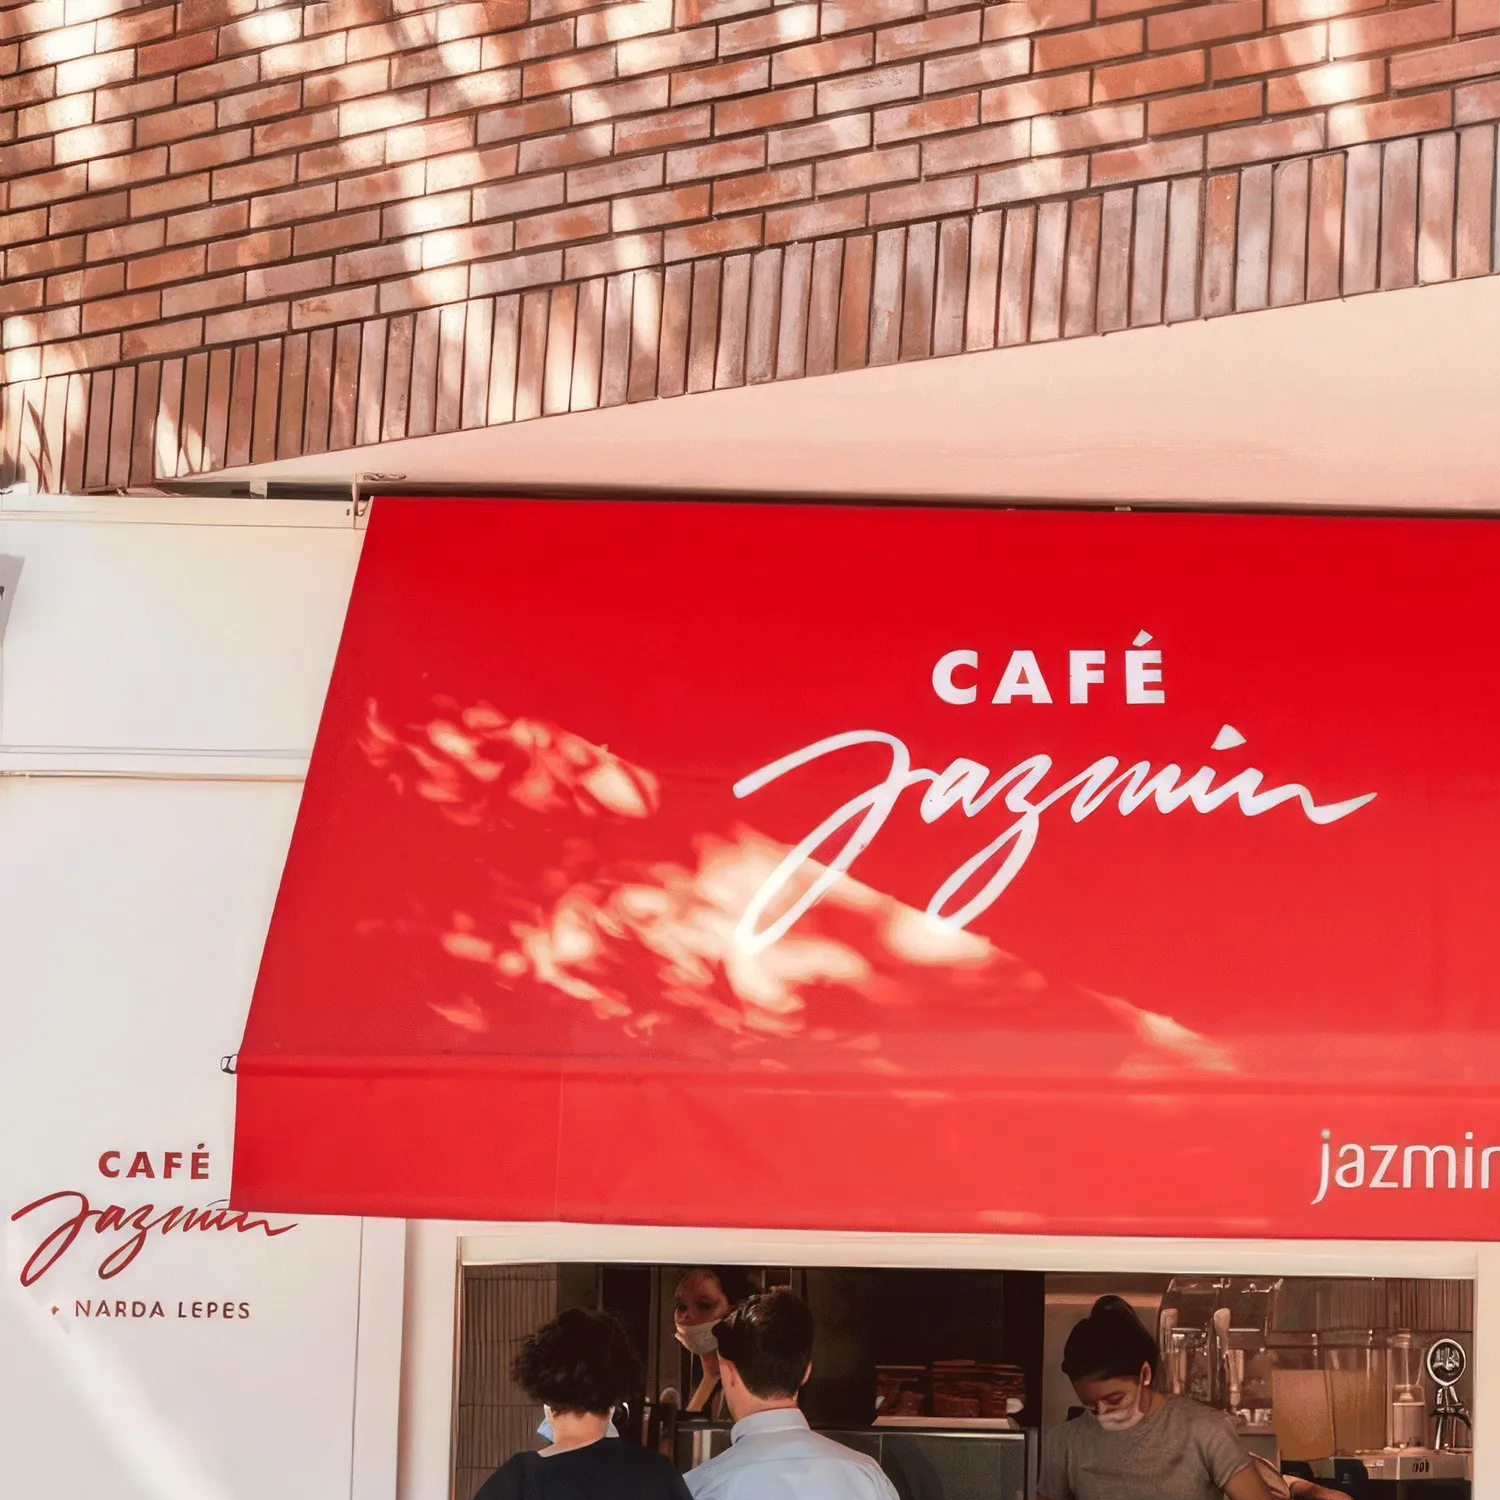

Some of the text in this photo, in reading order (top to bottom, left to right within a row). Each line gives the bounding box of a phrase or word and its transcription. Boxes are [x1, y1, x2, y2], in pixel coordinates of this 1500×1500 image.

[932, 629, 1165, 705] CAFÉ
[98, 1142, 210, 1180] CAFÉ
[75, 1299, 250, 1320] NARDA LEPES
